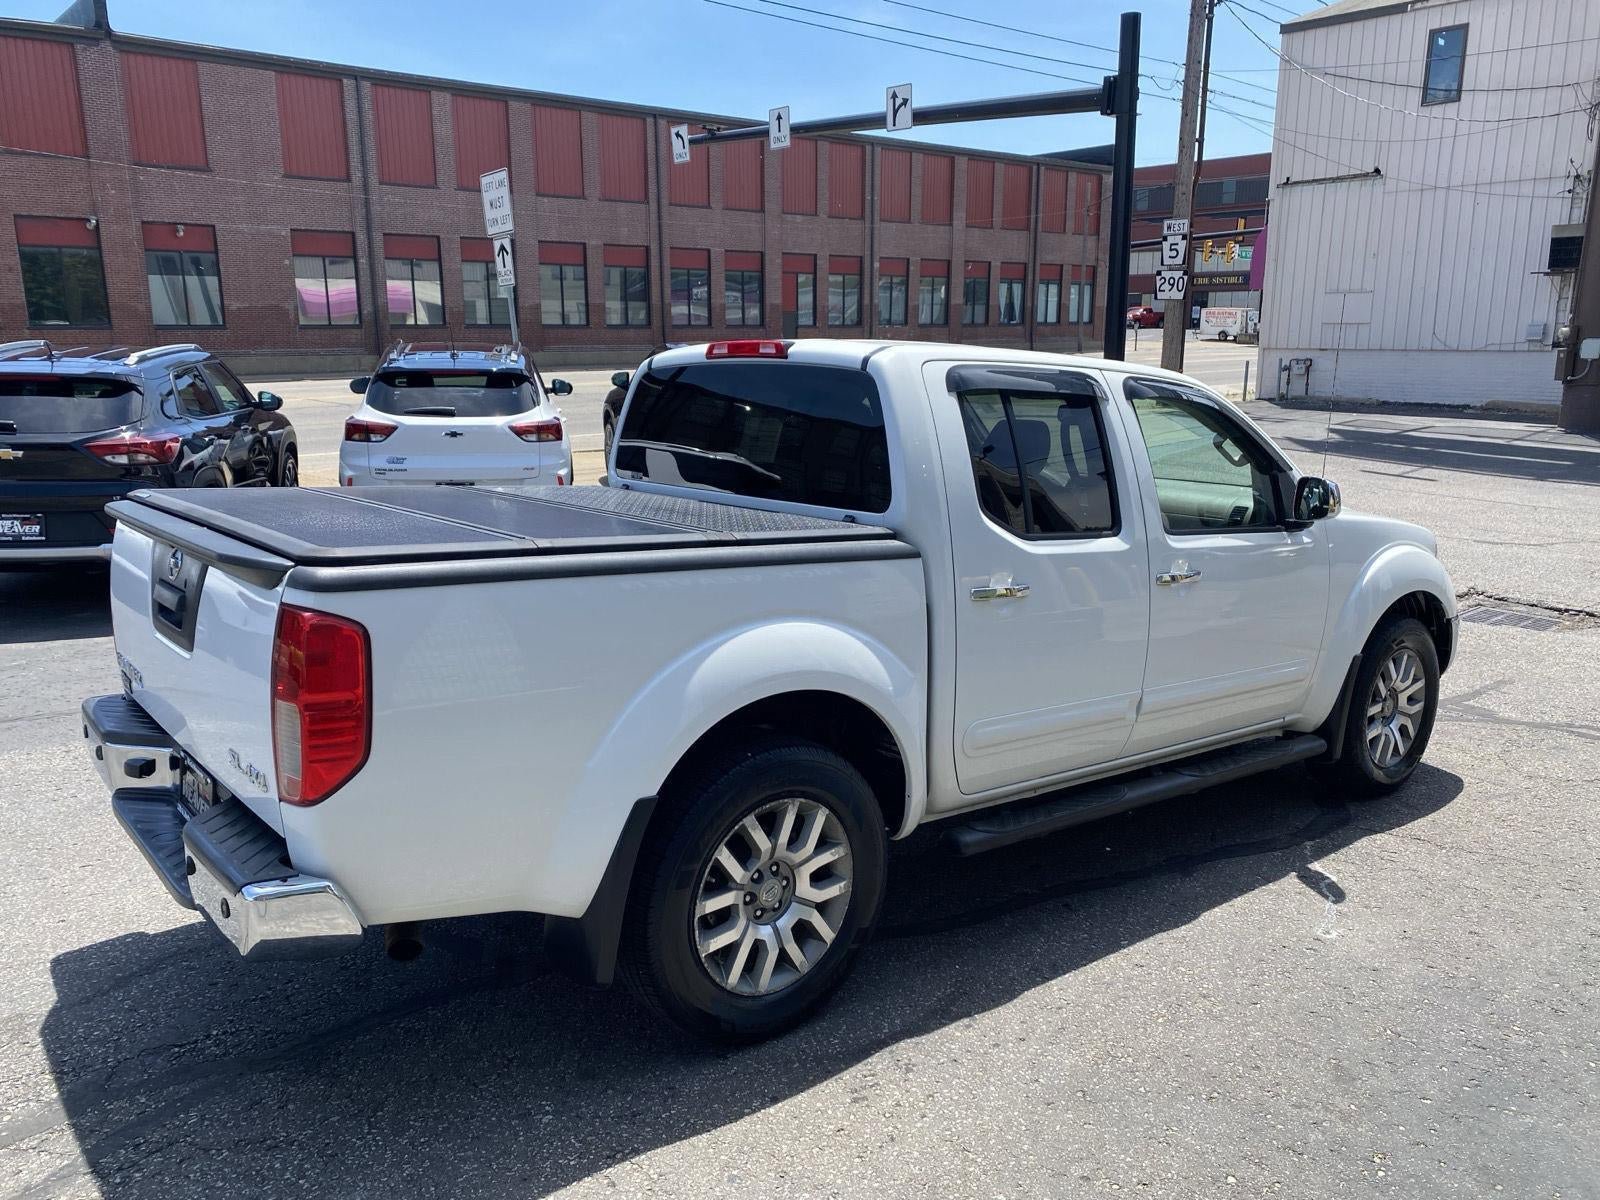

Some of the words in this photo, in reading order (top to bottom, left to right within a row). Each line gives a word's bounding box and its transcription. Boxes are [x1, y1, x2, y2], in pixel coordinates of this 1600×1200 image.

[773, 135, 787, 145] ONLY
[675, 152, 688, 160] ONLY
[483, 181, 494, 193] LEFT
[494, 177, 507, 190] LANE
[489, 195, 504, 210] MUST
[487, 217, 499, 228] TURN
[499, 213, 511, 226] LEFT
[1166, 222, 1186, 232] WEST
[1168, 243, 1179, 259] 5
[498, 269, 513, 278] BLACK
[1158, 276, 1185, 293] 290
